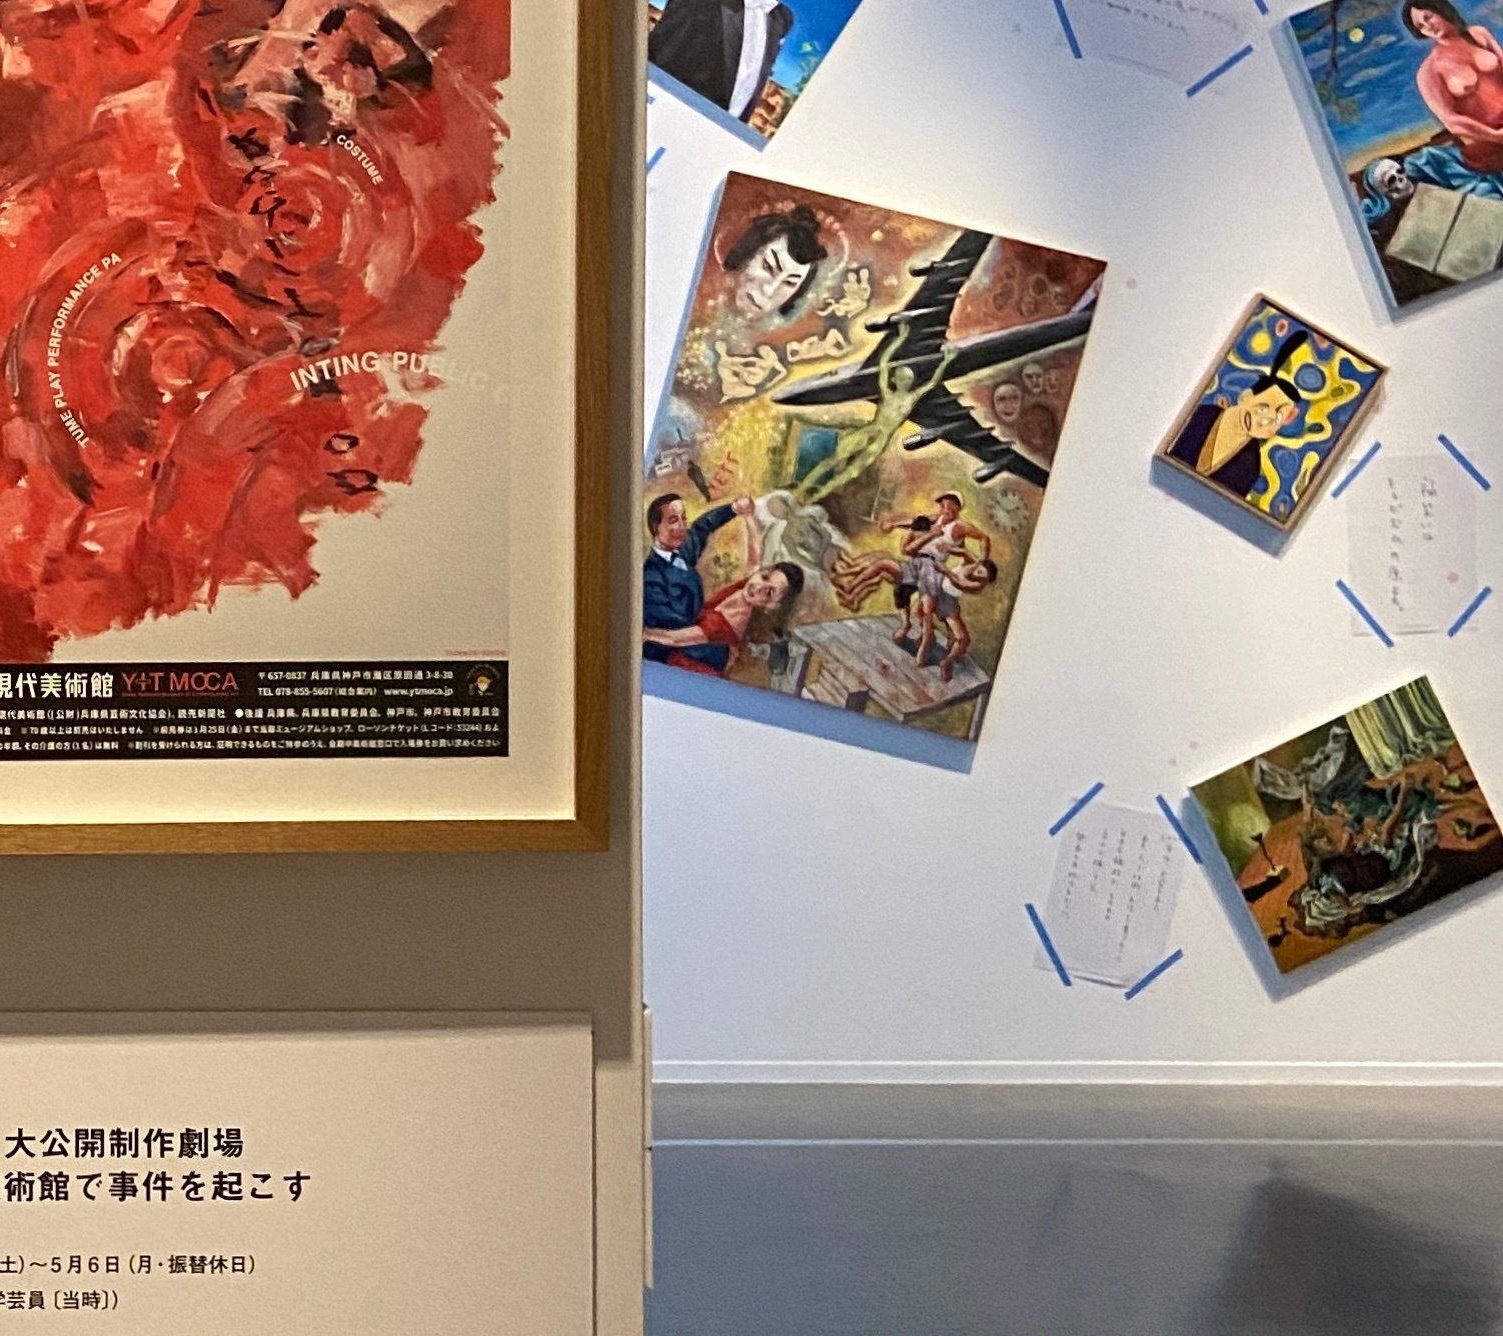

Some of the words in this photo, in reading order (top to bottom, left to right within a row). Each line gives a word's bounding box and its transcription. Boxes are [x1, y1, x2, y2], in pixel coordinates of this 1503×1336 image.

[336, 134, 384, 186] COSTUME
[101, 252, 123, 270] PA
[48, 265, 102, 367] PERFORMANCE
[48, 371, 68, 410] PLAY
[59, 408, 90, 449] TUME
[169, 671, 239, 692] MOCA
[4, 1127, 244, 1160] 大公開制作劇場
